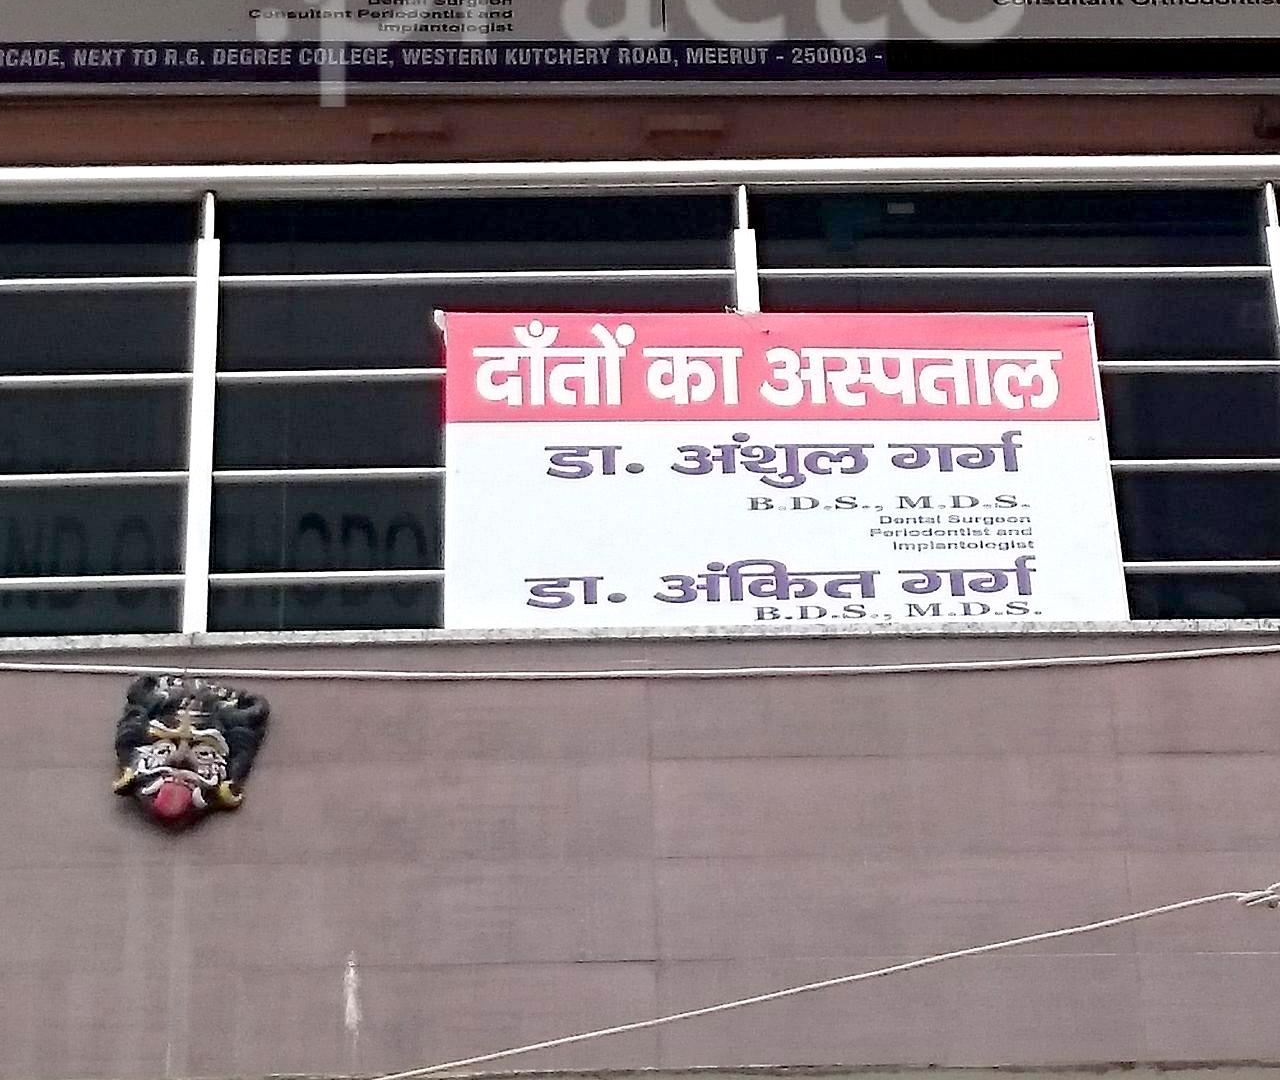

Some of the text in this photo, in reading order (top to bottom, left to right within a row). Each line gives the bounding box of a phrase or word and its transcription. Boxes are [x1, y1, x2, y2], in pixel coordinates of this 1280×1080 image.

[73, 48, 125, 68] NEXT
[131, 48, 158, 67] TO
[164, 48, 205, 67] R.G.
[213, 47, 291, 66] DEGREE
[298, 47, 394, 69] COLLEGE,
[402, 47, 498, 66] WESTERN
[505, 47, 613, 66] KUTCHERY
[618, 47, 679, 68] ROAD,
[686, 46, 769, 65] MEERUT
[791, 46, 867, 64] 250003
[473, 319, 1063, 410] दाँतों का अस्पताल
[545, 430, 1023, 488] डा. अंशुल गर्ग
[747, 494, 1031, 512] B.D.S., M.D.S.
[879, 514, 1031, 525] Dental Surgeon
[525, 555, 1037, 610] डा. अंकित गर्ग
